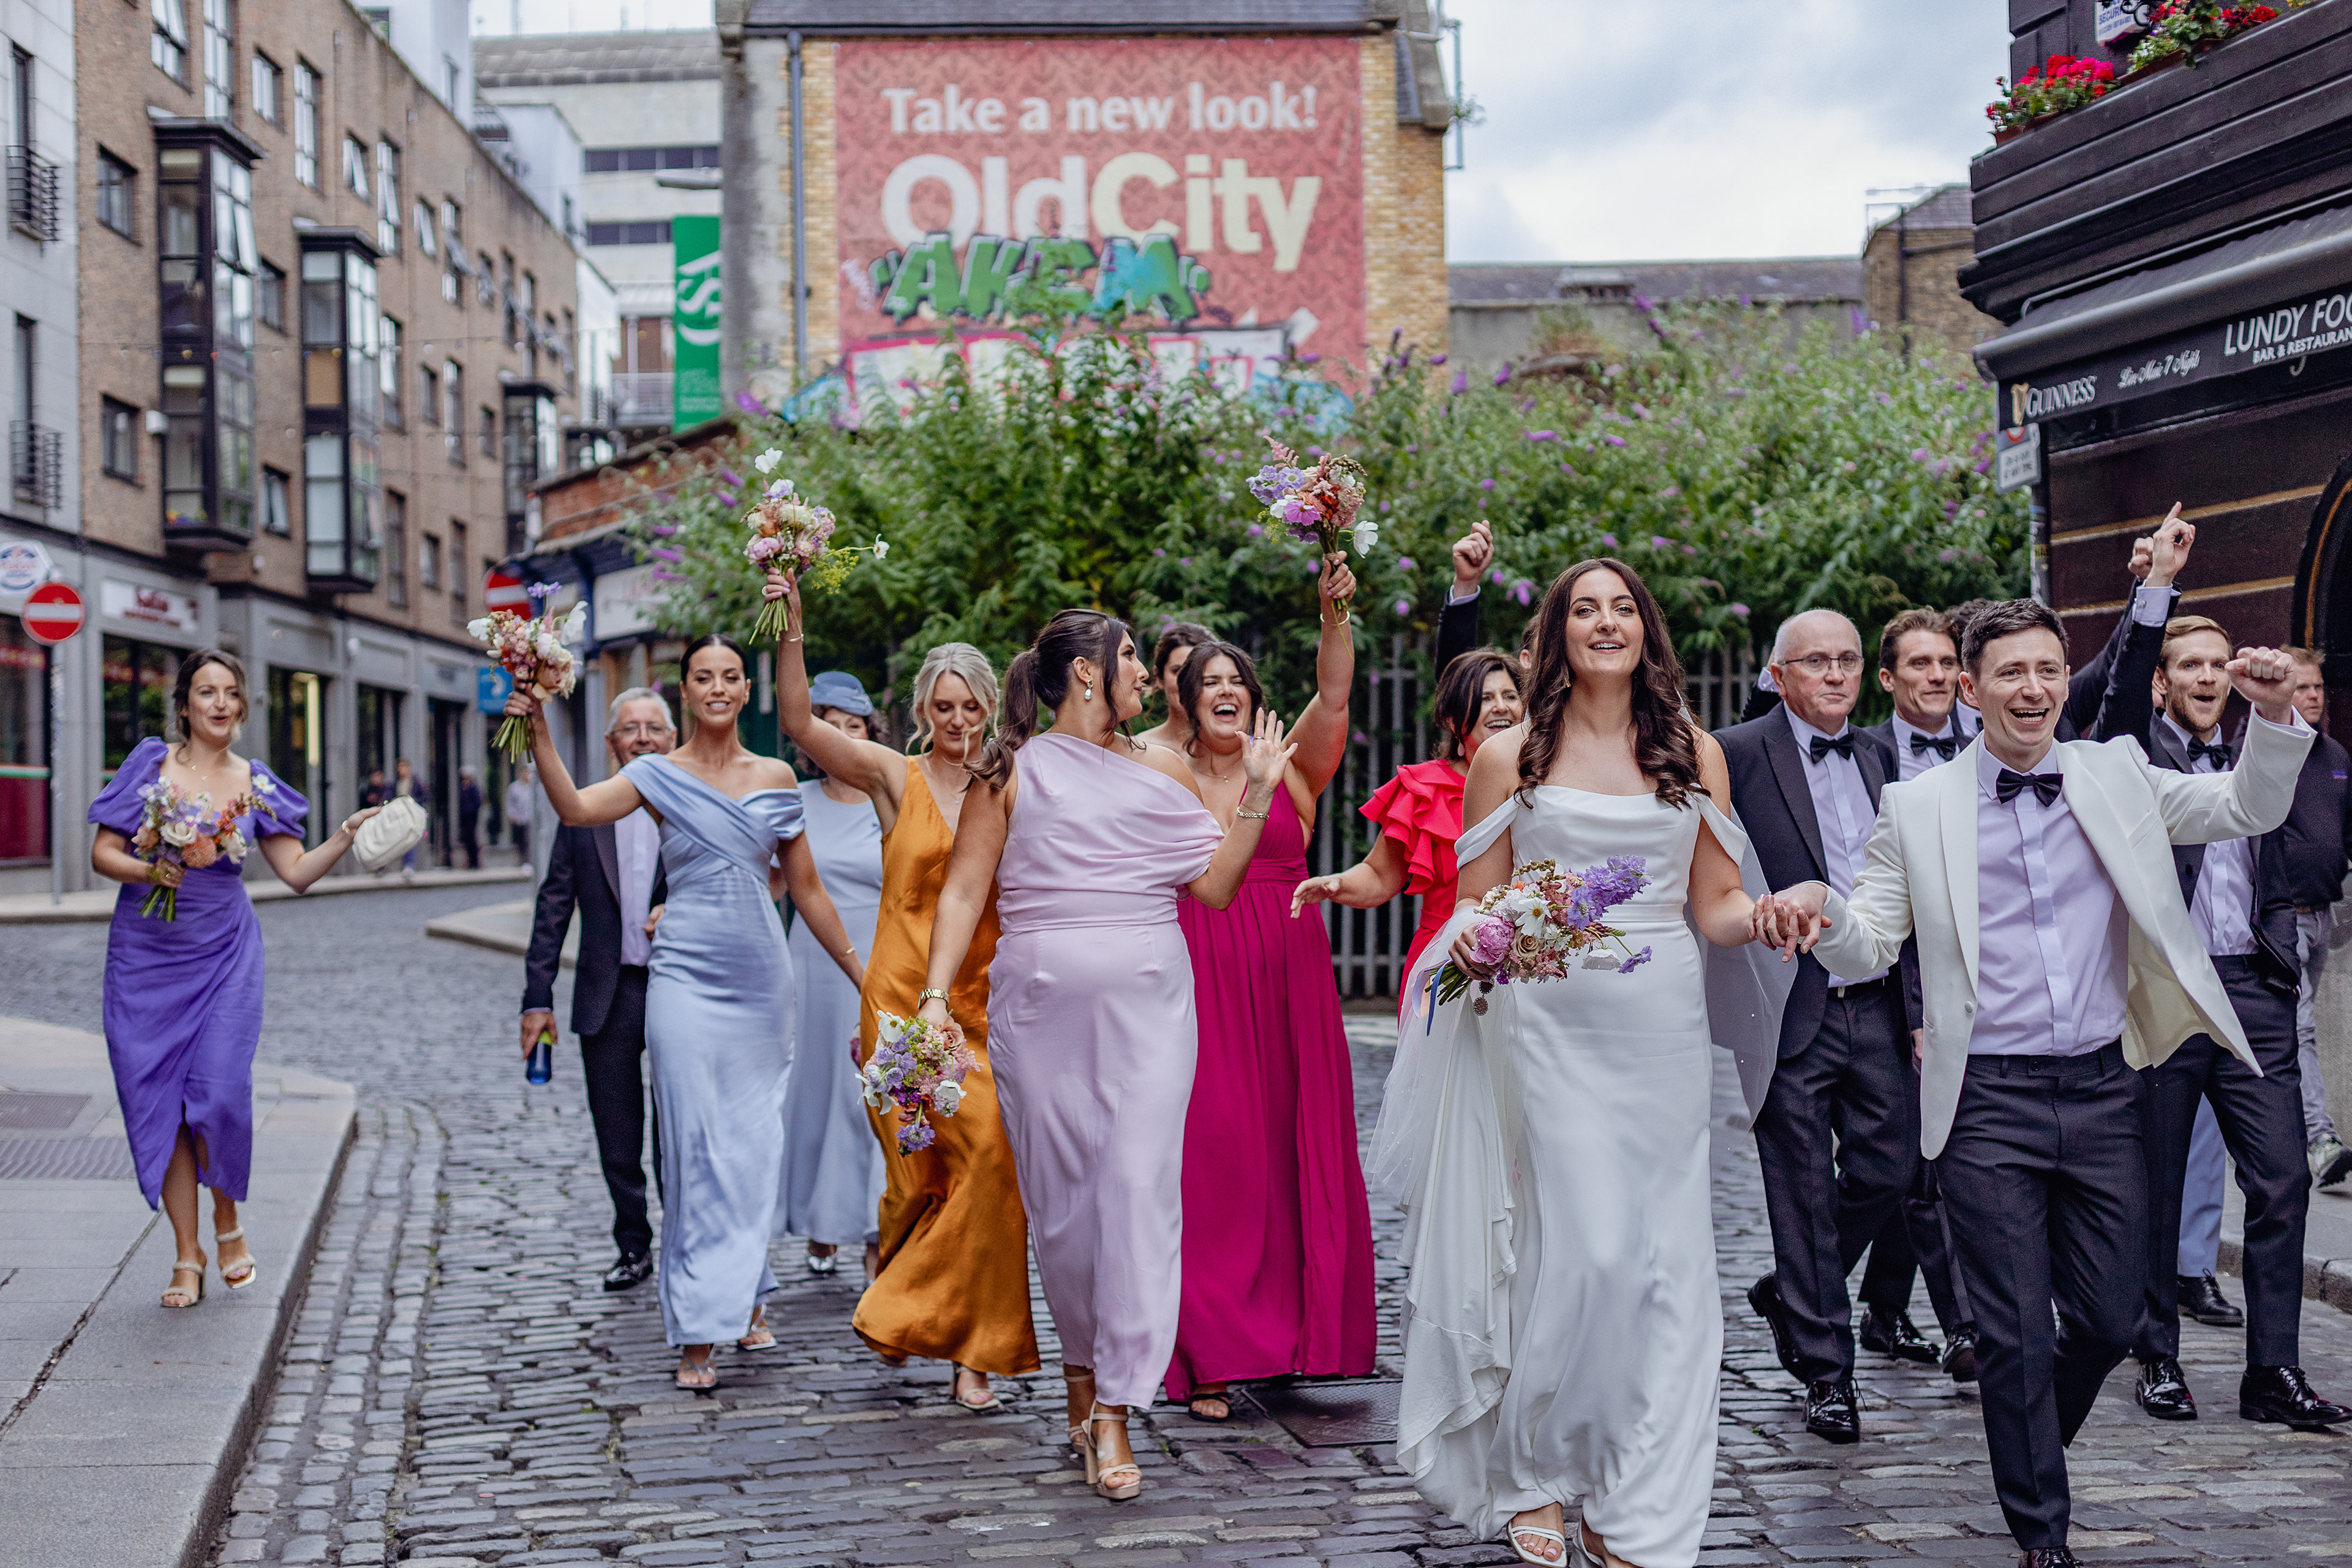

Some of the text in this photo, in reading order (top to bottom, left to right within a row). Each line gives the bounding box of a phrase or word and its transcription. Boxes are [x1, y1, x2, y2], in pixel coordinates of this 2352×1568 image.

[2099, 5, 2130, 25] SECUR
[880, 81, 1318, 134] Take a new look!
[881, 153, 1322, 271] OldCity
[2225, 304, 2307, 356] LUNDY
[2252, 347, 2276, 364] BAR
[2277, 344, 2286, 358] &
[2026, 375, 2097, 418] GUINNESS
